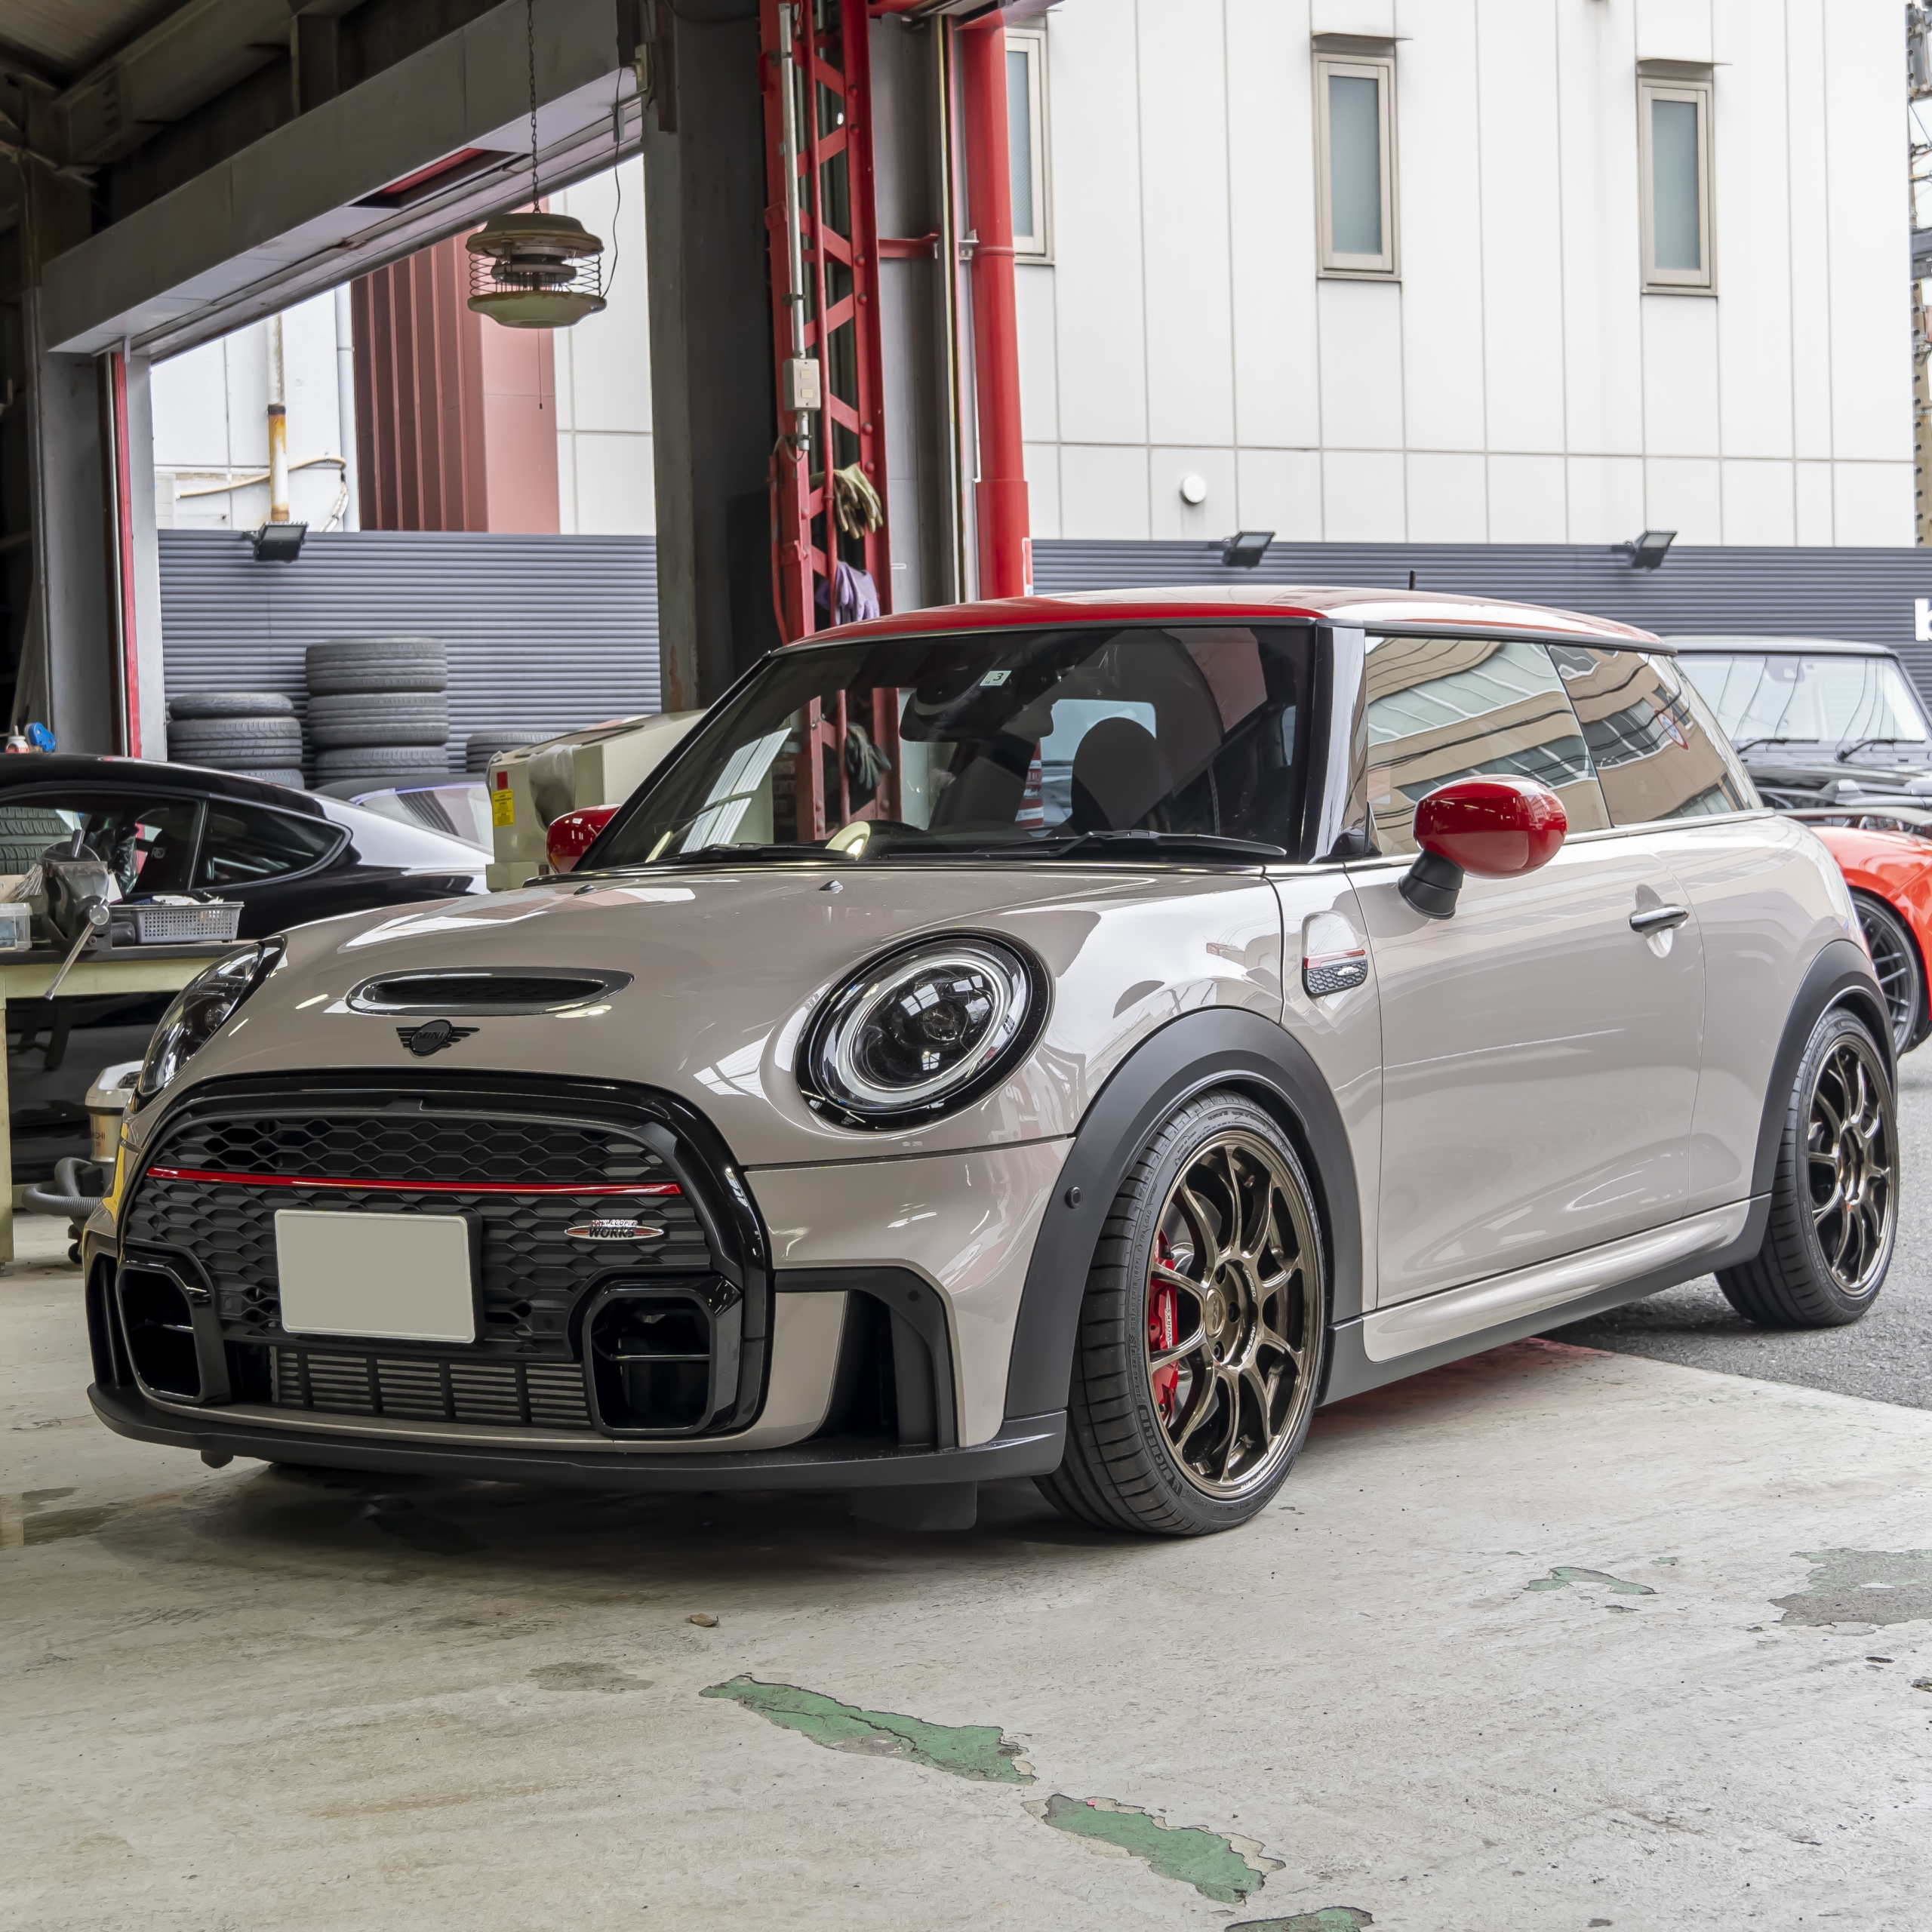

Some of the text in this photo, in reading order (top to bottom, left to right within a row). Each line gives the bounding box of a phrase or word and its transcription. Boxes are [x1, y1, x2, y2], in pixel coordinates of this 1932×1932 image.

[992, 672, 1004, 681] 3
[415, 1031, 446, 1039] MINI
[610, 1219, 638, 1227] COOPER
[589, 1227, 635, 1238] WORKS
[1137, 1230, 1146, 1253] EXTRA
[1144, 1210, 1152, 1228] LOAD
[1244, 1269, 1257, 1297] FORGED
[1140, 1409, 1174, 1480] MICHELIN
